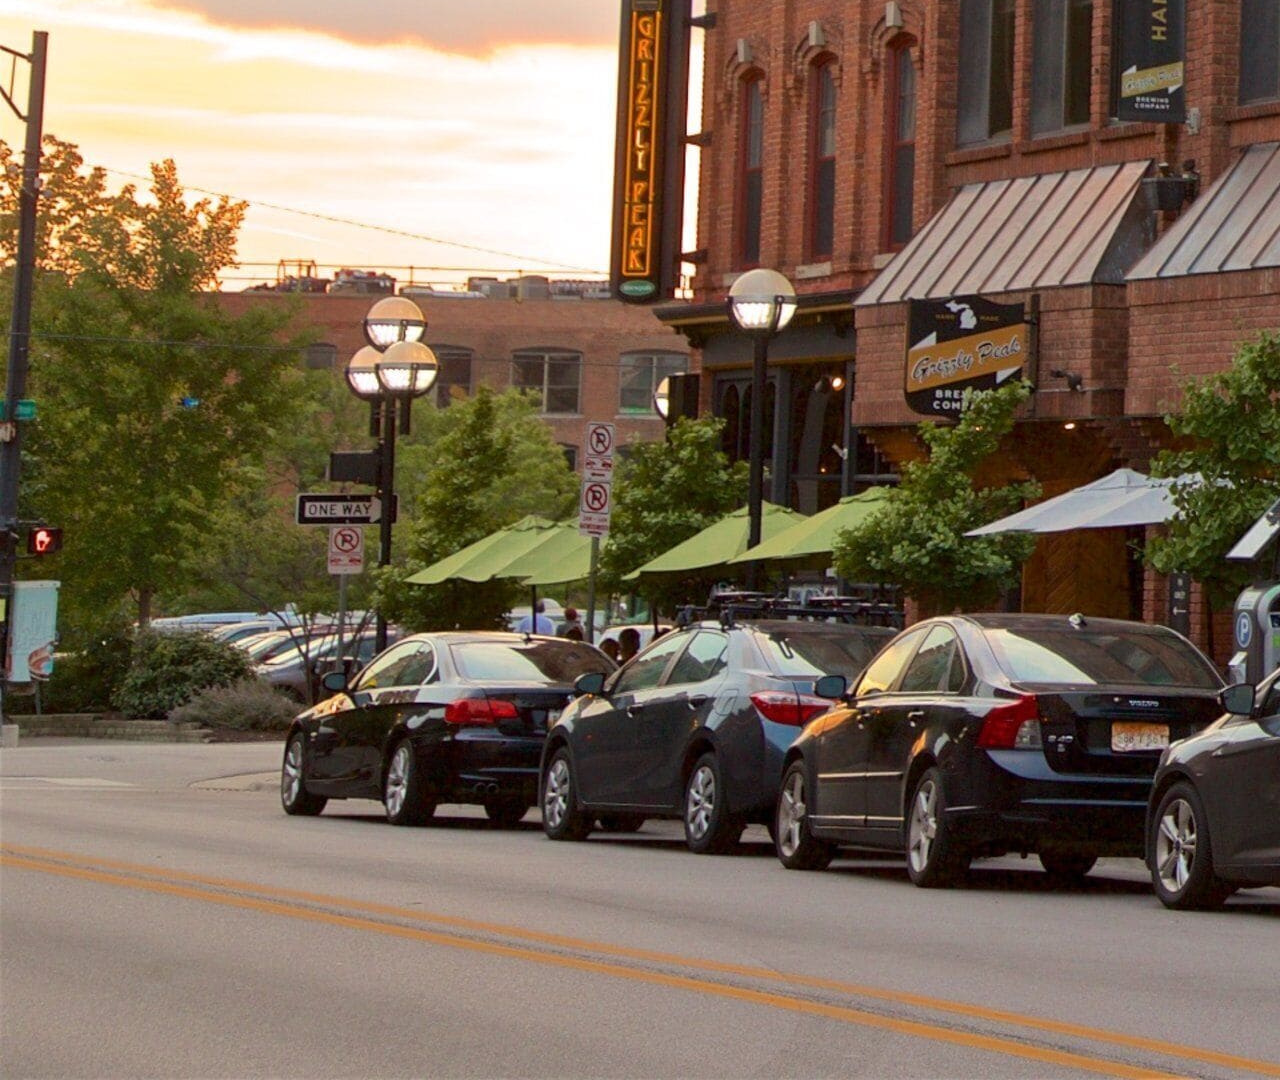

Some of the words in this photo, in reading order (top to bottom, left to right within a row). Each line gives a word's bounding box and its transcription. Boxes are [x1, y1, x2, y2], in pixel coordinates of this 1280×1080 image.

[635, 16, 654, 171] GRIZZLY
[1136, 96, 1169, 104] BREWING
[631, 182, 647, 271] PEAK
[912, 350, 974, 383] Grizzly
[976, 334, 1020, 364] Peak
[308, 503, 337, 516] ONE
[342, 503, 372, 516] WAY
